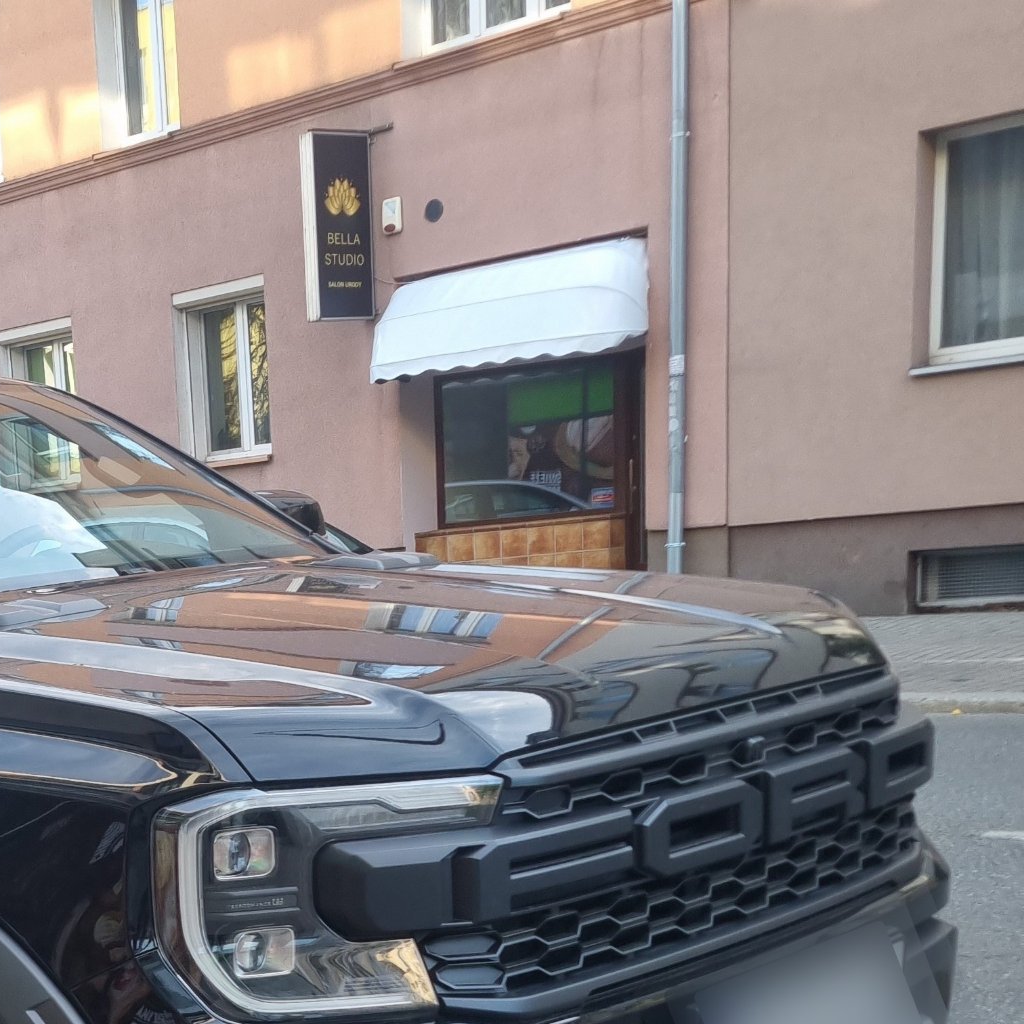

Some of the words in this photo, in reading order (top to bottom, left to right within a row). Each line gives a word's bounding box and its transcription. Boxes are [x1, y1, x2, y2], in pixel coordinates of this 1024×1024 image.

[327, 232, 360, 245] BELLA
[324, 253, 365, 266] STUDIO
[476, 718, 936, 923] FORD
